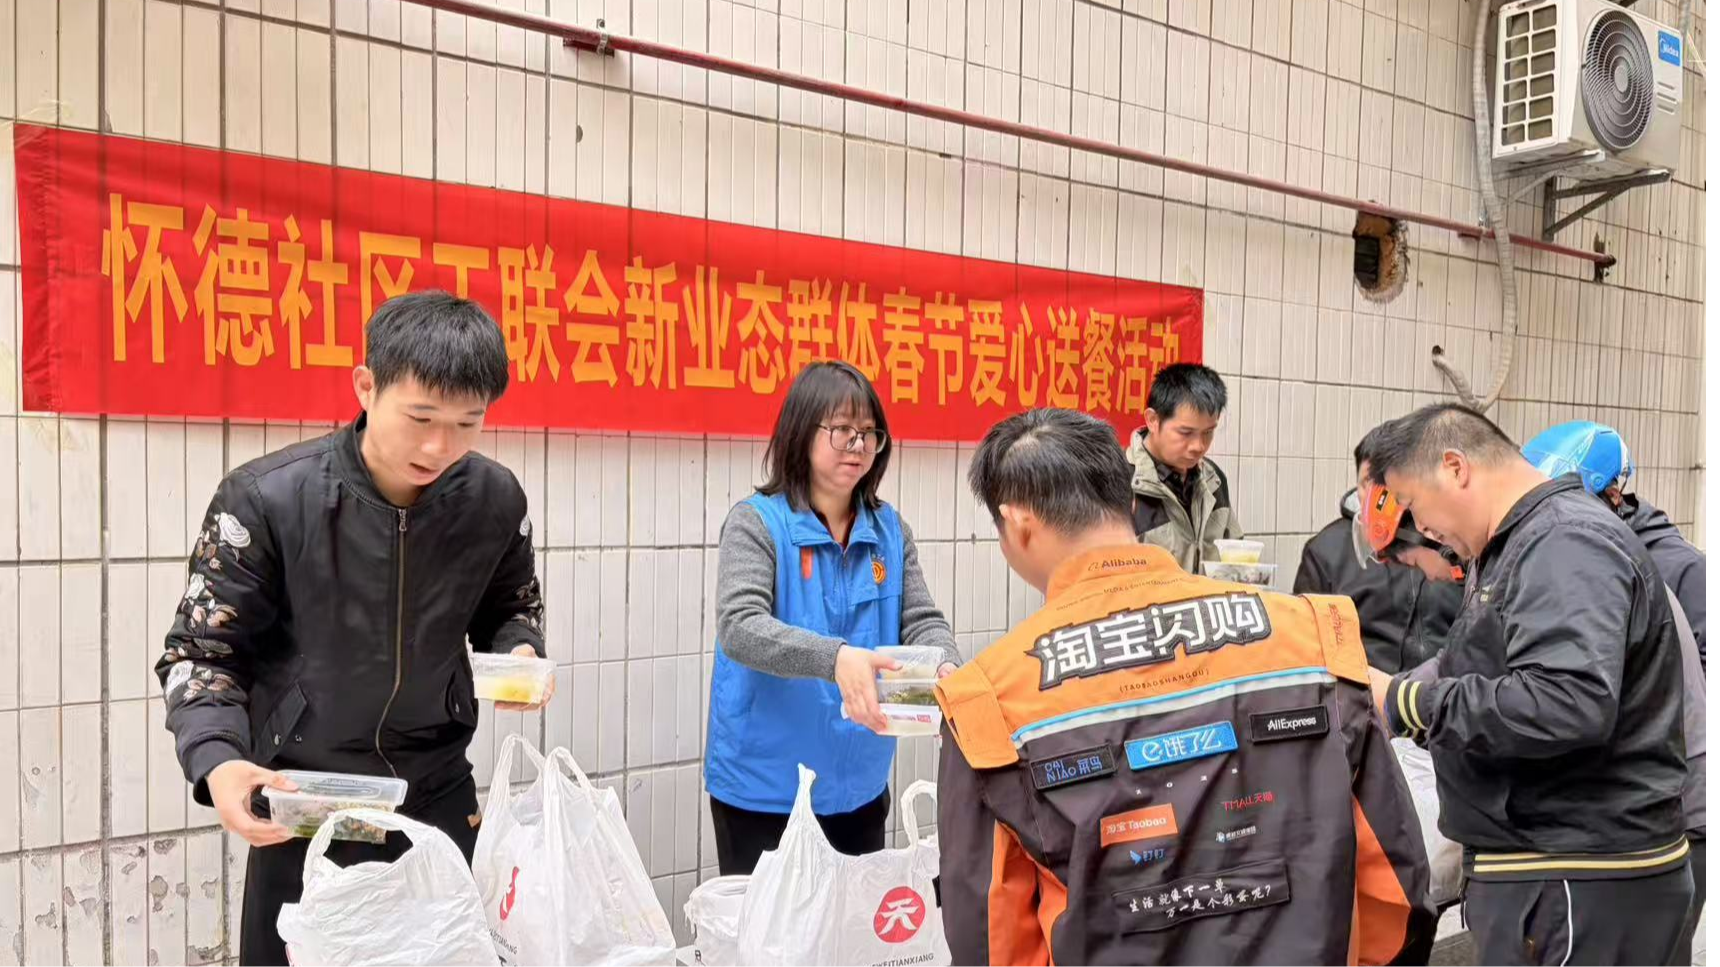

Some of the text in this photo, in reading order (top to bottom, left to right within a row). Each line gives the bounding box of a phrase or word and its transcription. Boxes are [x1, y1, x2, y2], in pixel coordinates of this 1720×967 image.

[1101, 558, 1147, 569] Alibaba
[1041, 594, 1265, 681] 淘宝闪购
[1267, 717, 1317, 731] AliExpress
[1046, 766, 1076, 783] NIAO
[1130, 878, 1226, 912] 生活就像下一单
[878, 897, 919, 935] 天
[869, 953, 934, 967] WEITIANXIANG
